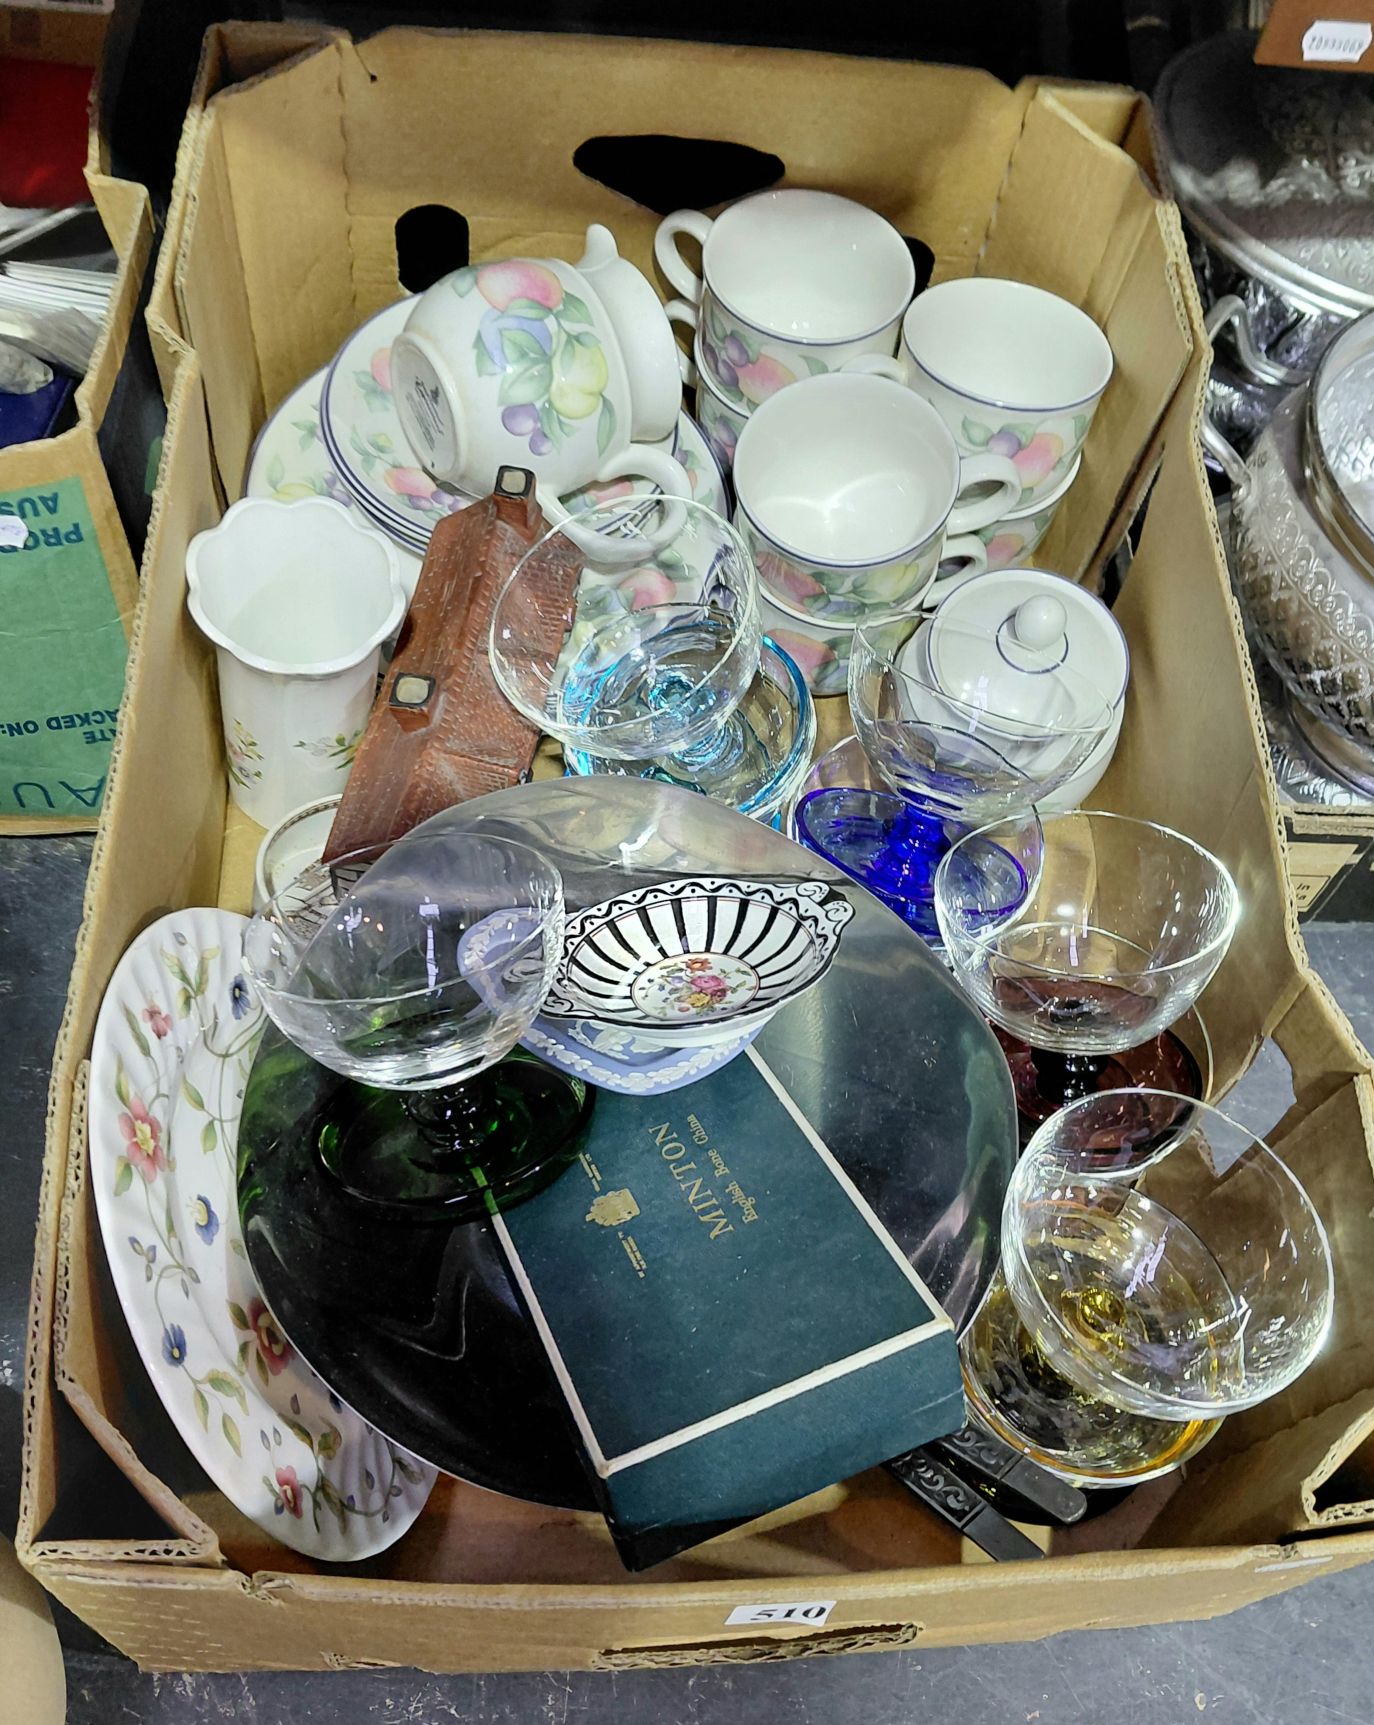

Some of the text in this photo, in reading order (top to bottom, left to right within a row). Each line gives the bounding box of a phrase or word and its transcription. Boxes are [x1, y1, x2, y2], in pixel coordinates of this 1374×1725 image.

[0, 720, 39, 737] ON:
[648, 1122, 735, 1240] MINTON
[687, 1113, 759, 1224] English Bone China
[750, 1606, 826, 1621] 510
